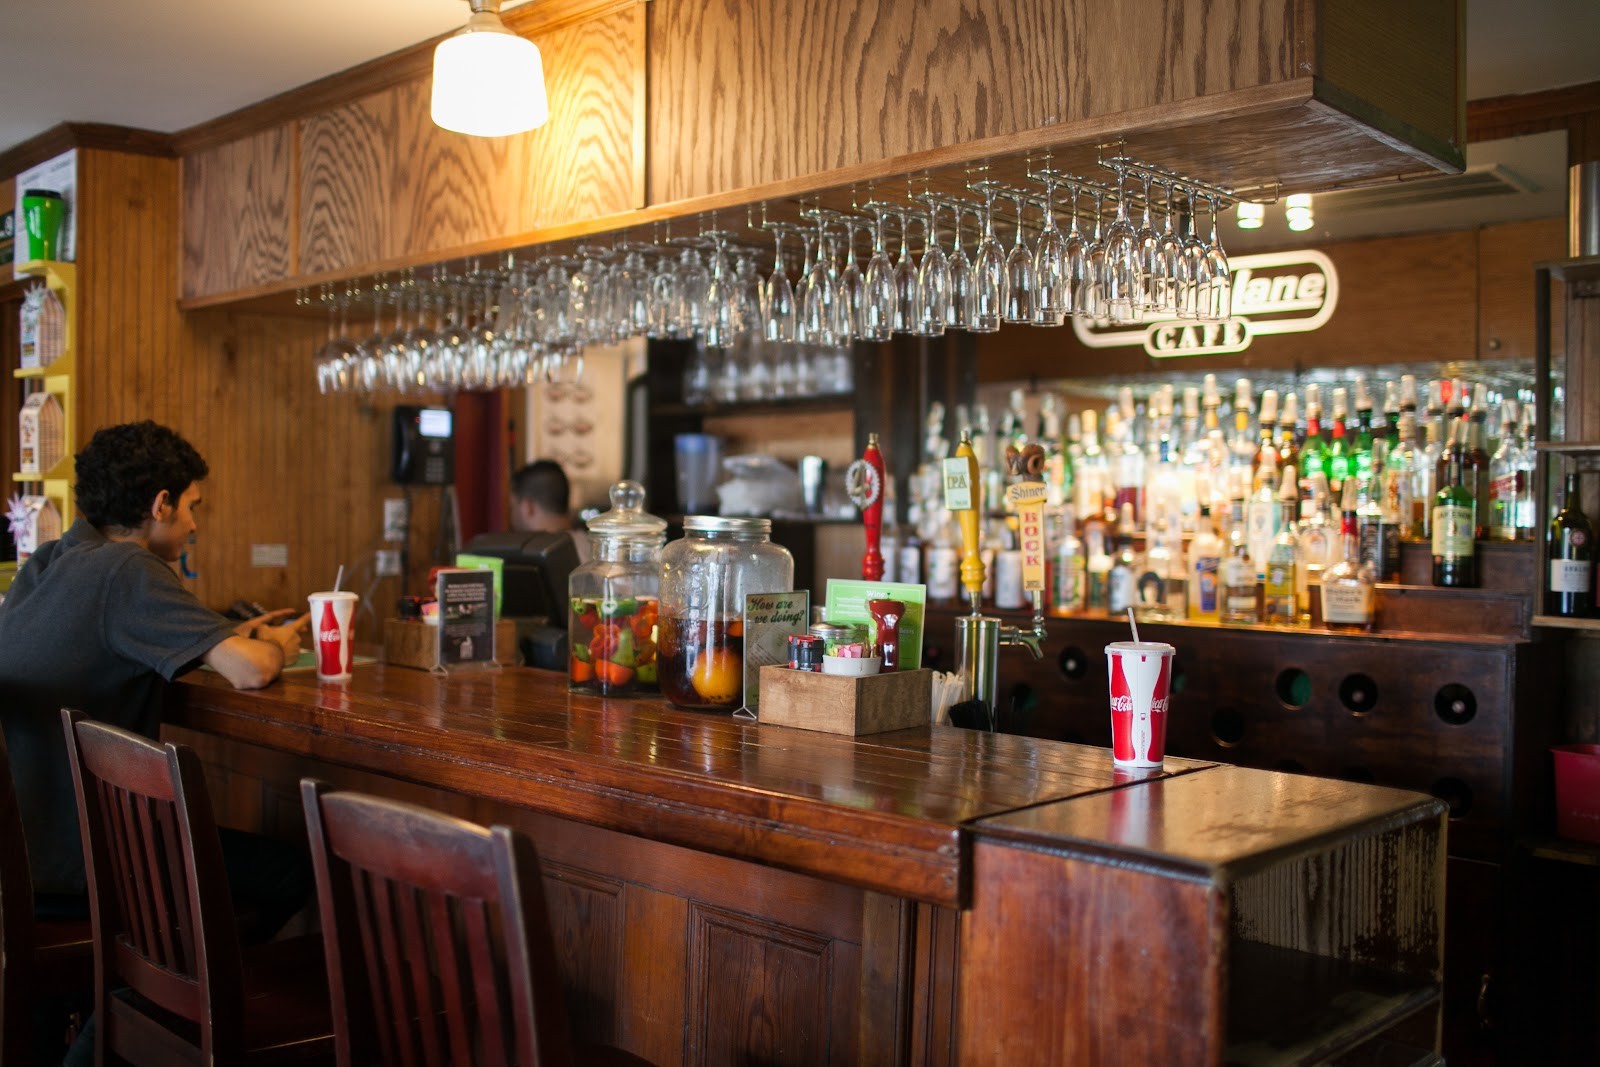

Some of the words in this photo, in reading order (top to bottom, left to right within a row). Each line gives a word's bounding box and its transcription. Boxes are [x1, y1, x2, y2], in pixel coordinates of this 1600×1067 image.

[1156, 321, 1242, 349] CAFE
[1011, 484, 1046, 500] Shiner
[747, 598, 773, 612] How
[776, 600, 793, 610] are
[754, 614, 769, 624] we
[771, 609, 804, 626] doing?
